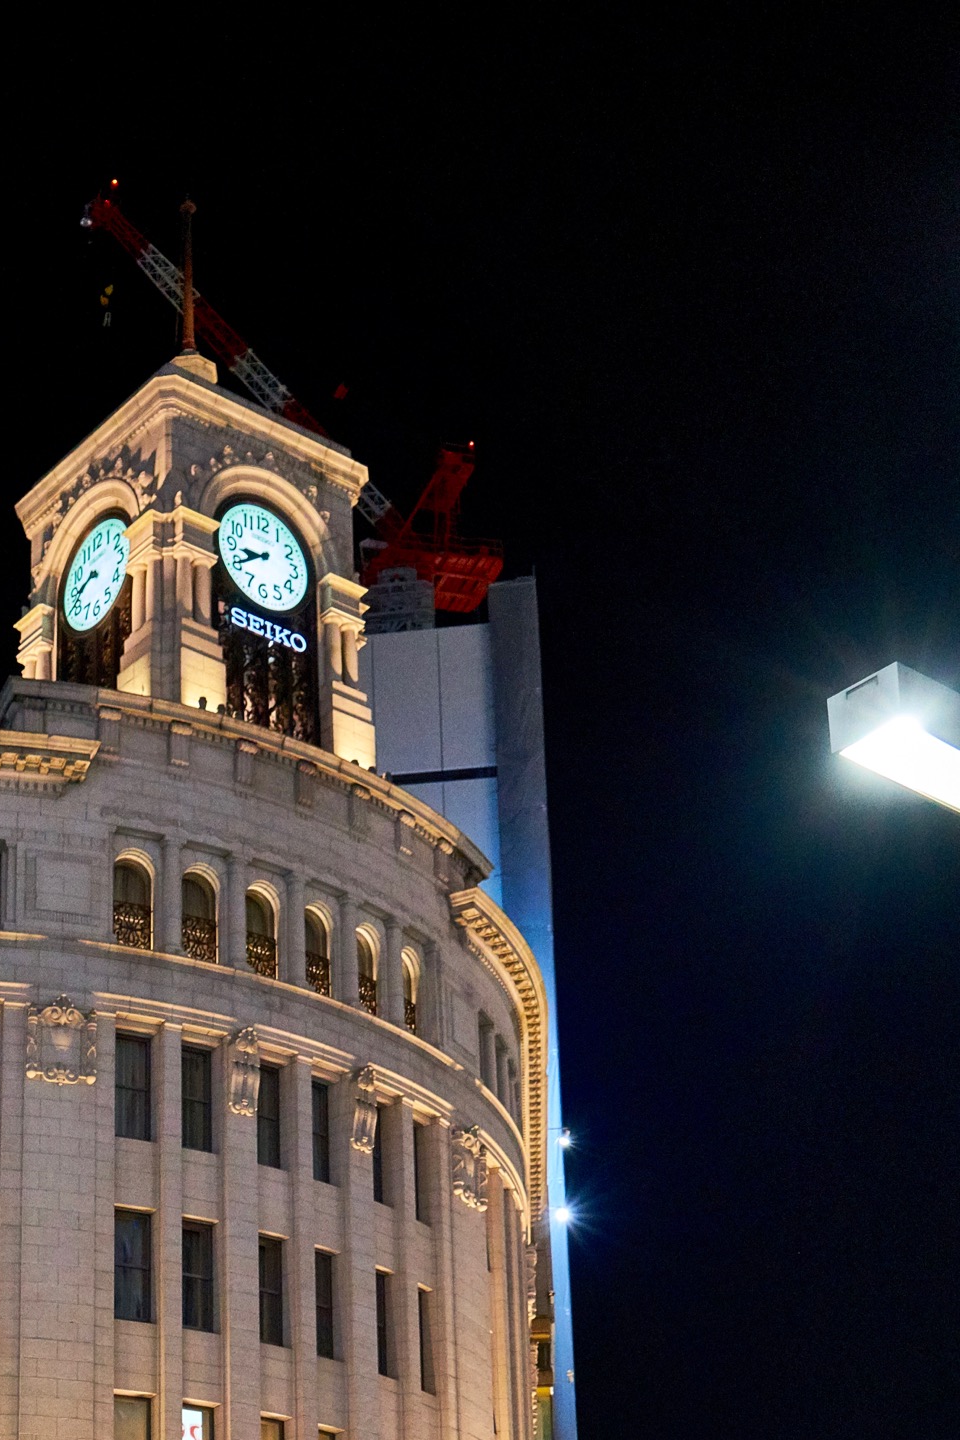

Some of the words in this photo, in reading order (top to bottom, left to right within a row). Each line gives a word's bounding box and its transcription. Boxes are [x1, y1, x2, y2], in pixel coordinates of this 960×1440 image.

[231, 520, 243, 538] 10
[244, 513, 253, 530] 11
[257, 515, 269, 533] 12
[93, 533, 102, 552] 12
[113, 533, 121, 550] 2
[227, 536, 237, 551] 9
[83, 547, 91, 564] 11
[117, 547, 125, 565] 3
[284, 544, 294, 561] 2
[232, 555, 242, 571] 8
[73, 566, 83, 584] 10
[112, 567, 120, 583] 4
[244, 572, 255, 587] 7
[289, 564, 298, 580] 3
[258, 584, 268, 598] 6
[273, 585, 282, 600] 5
[284, 579, 294, 594] 4
[104, 587, 112, 604] 5
[84, 602, 91, 620] 7
[92, 600, 101, 616] 6
[230, 606, 307, 653] SEIKO
